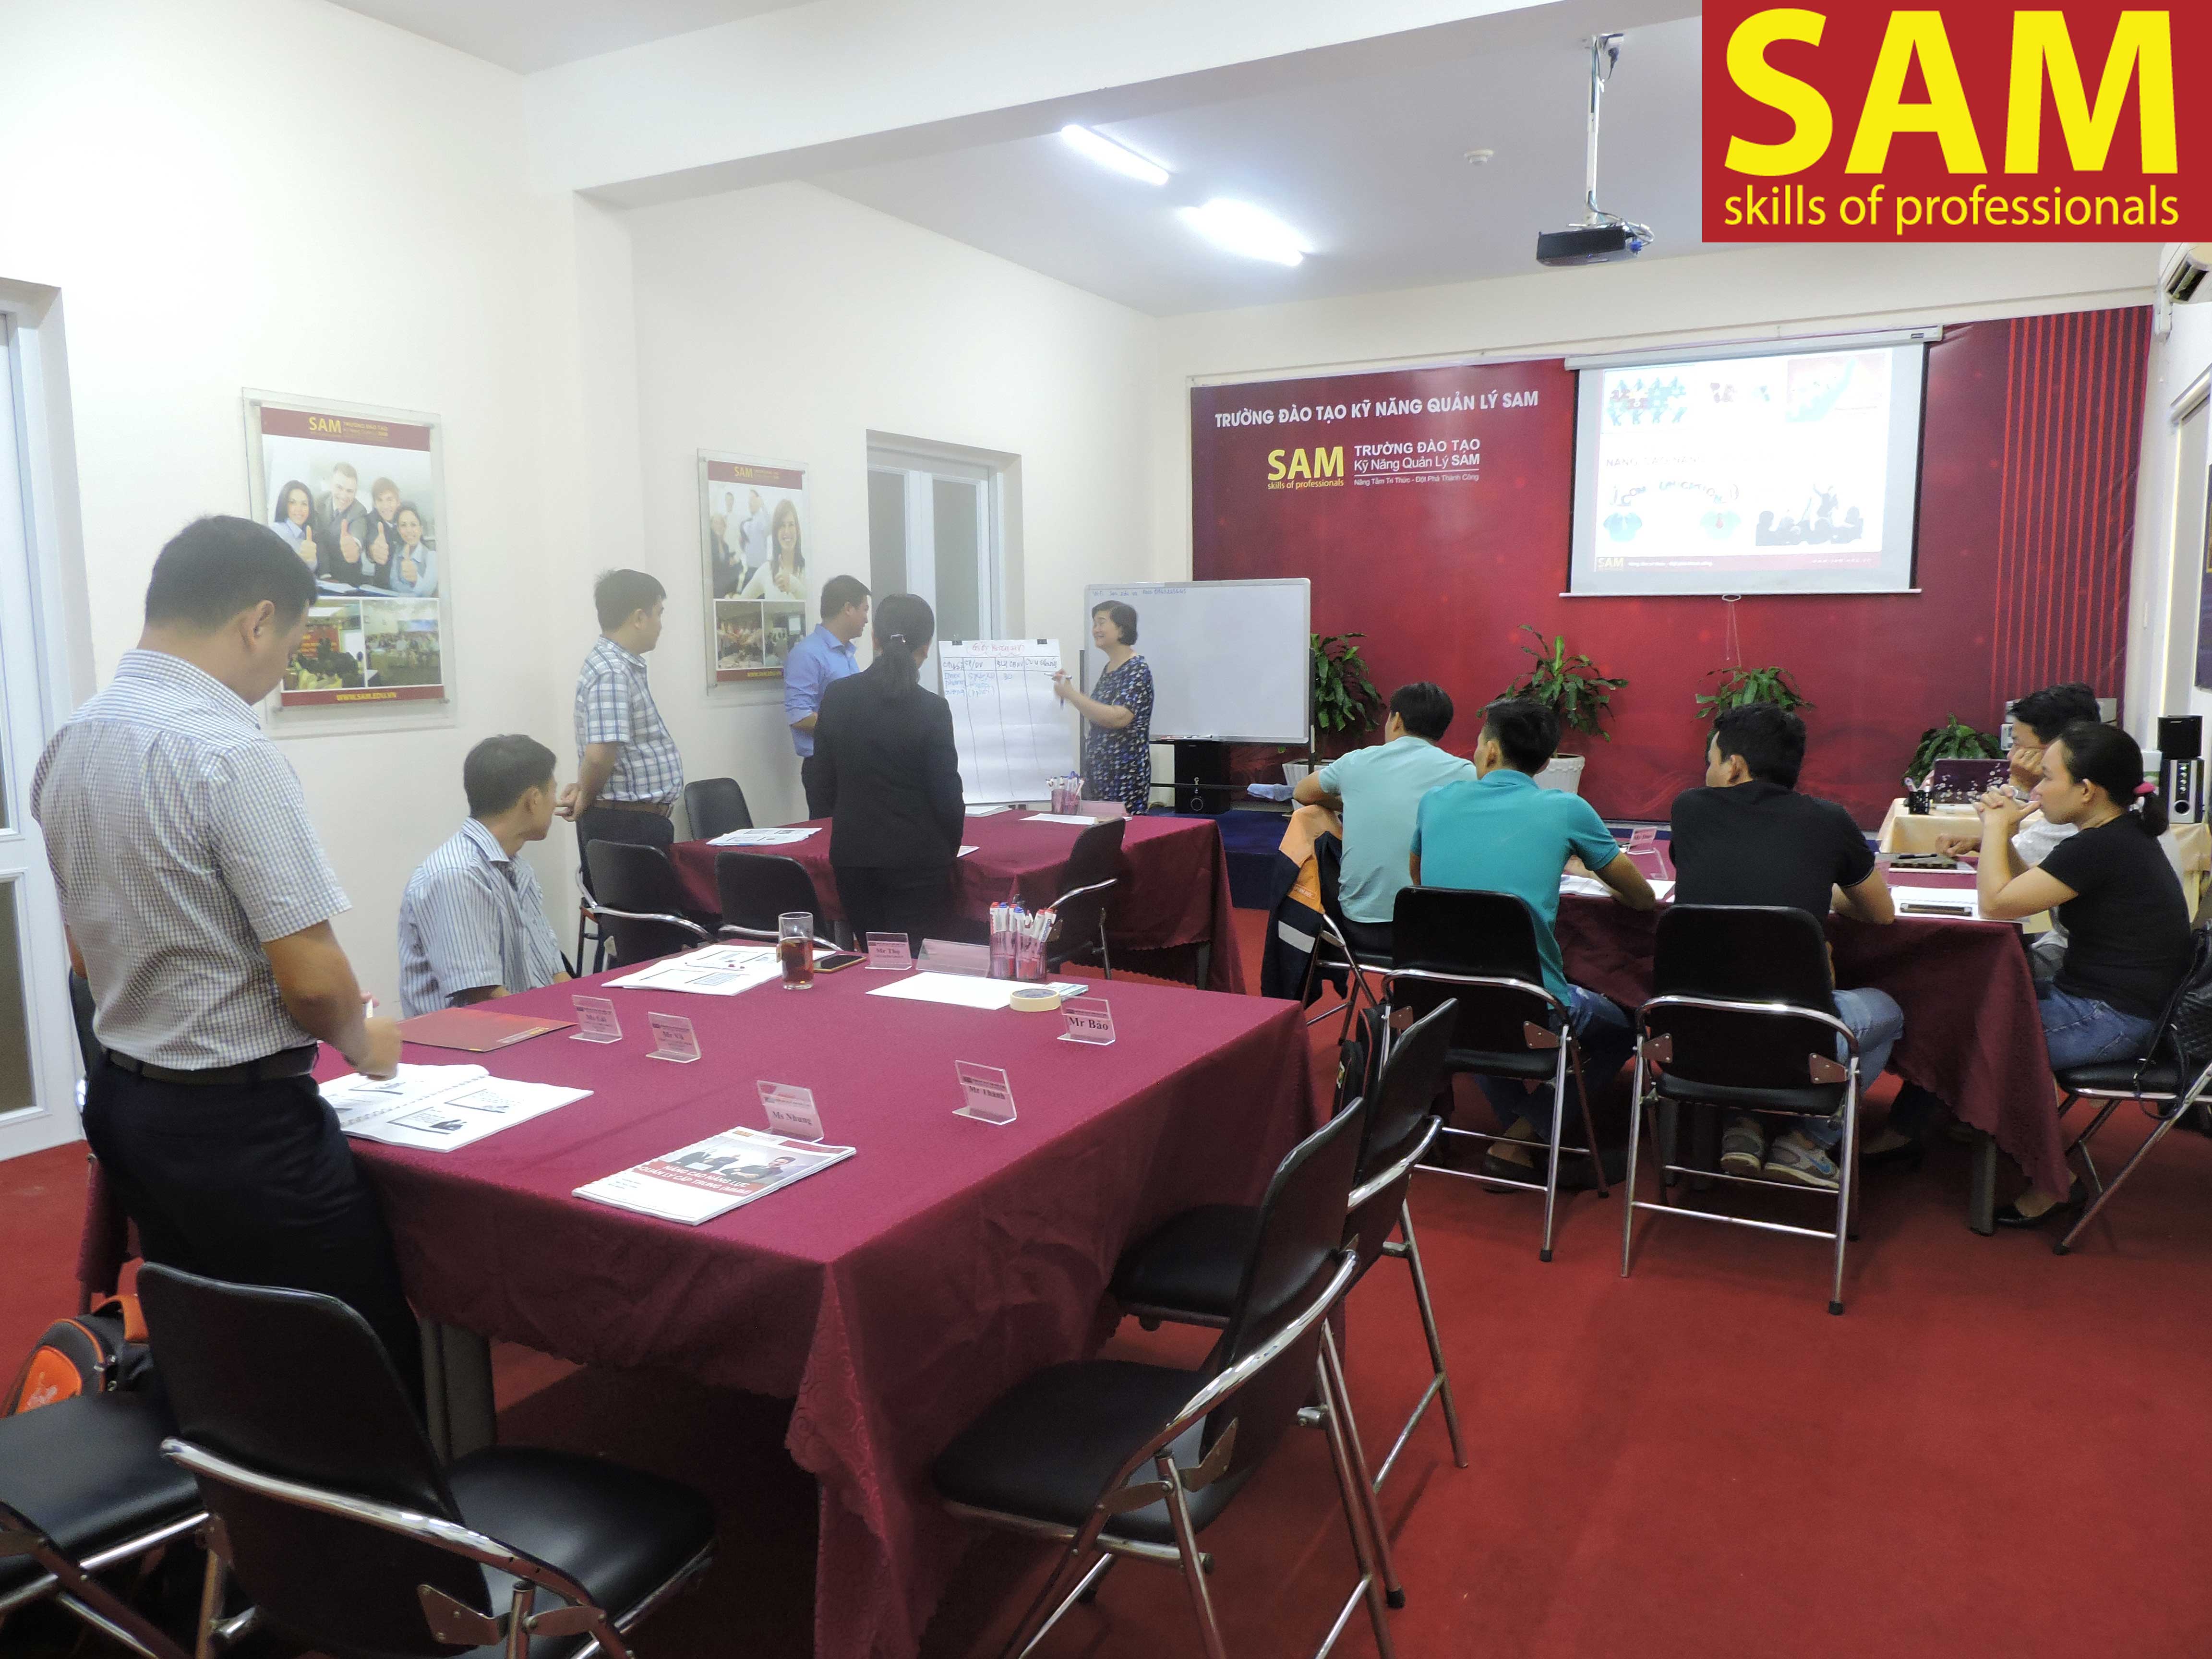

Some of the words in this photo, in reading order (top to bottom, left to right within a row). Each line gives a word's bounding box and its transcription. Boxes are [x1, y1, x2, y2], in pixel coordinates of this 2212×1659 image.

[1215, 408, 1274, 427] TRƯỜNG
[1278, 404, 1312, 423] ĐÀO
[1316, 405, 1346, 424] TẠO
[1351, 399, 1371, 418] KỸ
[1375, 397, 1423, 417] NĂNG
[1427, 391, 1475, 413] QUẢN
[1480, 389, 1498, 409] LÝ
[1503, 391, 1539, 408] SAM
[309, 417, 342, 433] SAM
[1354, 441, 1413, 457] TRƯỜNG
[1417, 439, 1447, 453] ĐÀO
[1452, 439, 1480, 454] TẠO
[1268, 446, 1344, 481] SAM
[1354, 459, 1369, 473] Kỹ
[1371, 459, 1400, 471] Năng
[1403, 456, 1432, 469] Quản
[1435, 456, 1449, 469] Lý
[1452, 454, 1480, 466] SAM
[734, 466, 753, 478] SAM
[1268, 481, 1285, 490] skills
[1286, 480, 1295, 489] of
[1296, 479, 1344, 490] professionals
[1598, 557, 1624, 568] SAM
[1070, 1017, 1085, 1027] Mr
[1089, 1019, 1108, 1030] Bảo
[773, 1111, 784, 1119] Ms
[786, 1113, 813, 1126] Nhung
